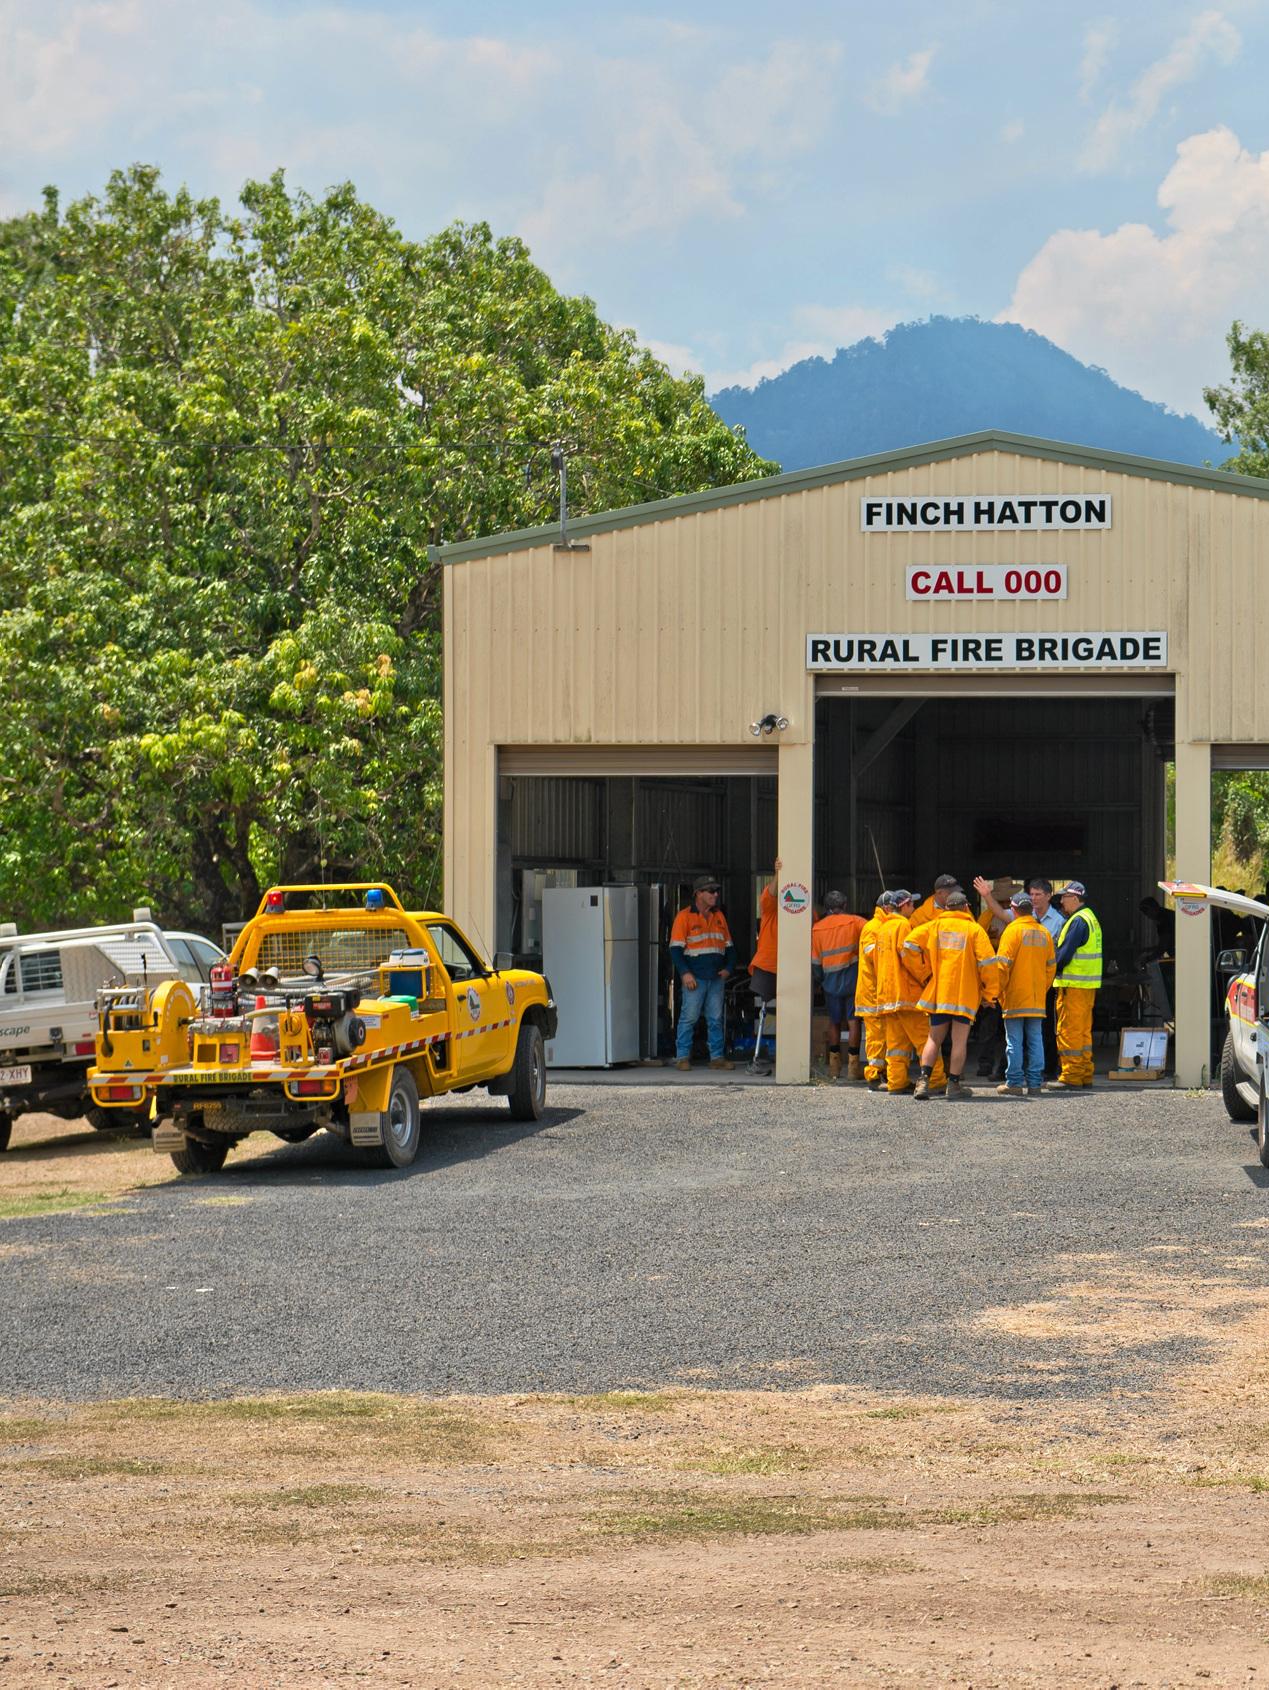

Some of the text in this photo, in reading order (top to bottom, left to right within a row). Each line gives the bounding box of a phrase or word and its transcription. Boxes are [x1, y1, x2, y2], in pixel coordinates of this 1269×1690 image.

[865, 499, 1106, 526] FINCH HATTON
[911, 569, 1062, 595] CALL 000
[811, 637, 1162, 663] RURAL FIRE BRIGADE
[174, 1072, 252, 1082] RURAL FIRE BRIGADE
